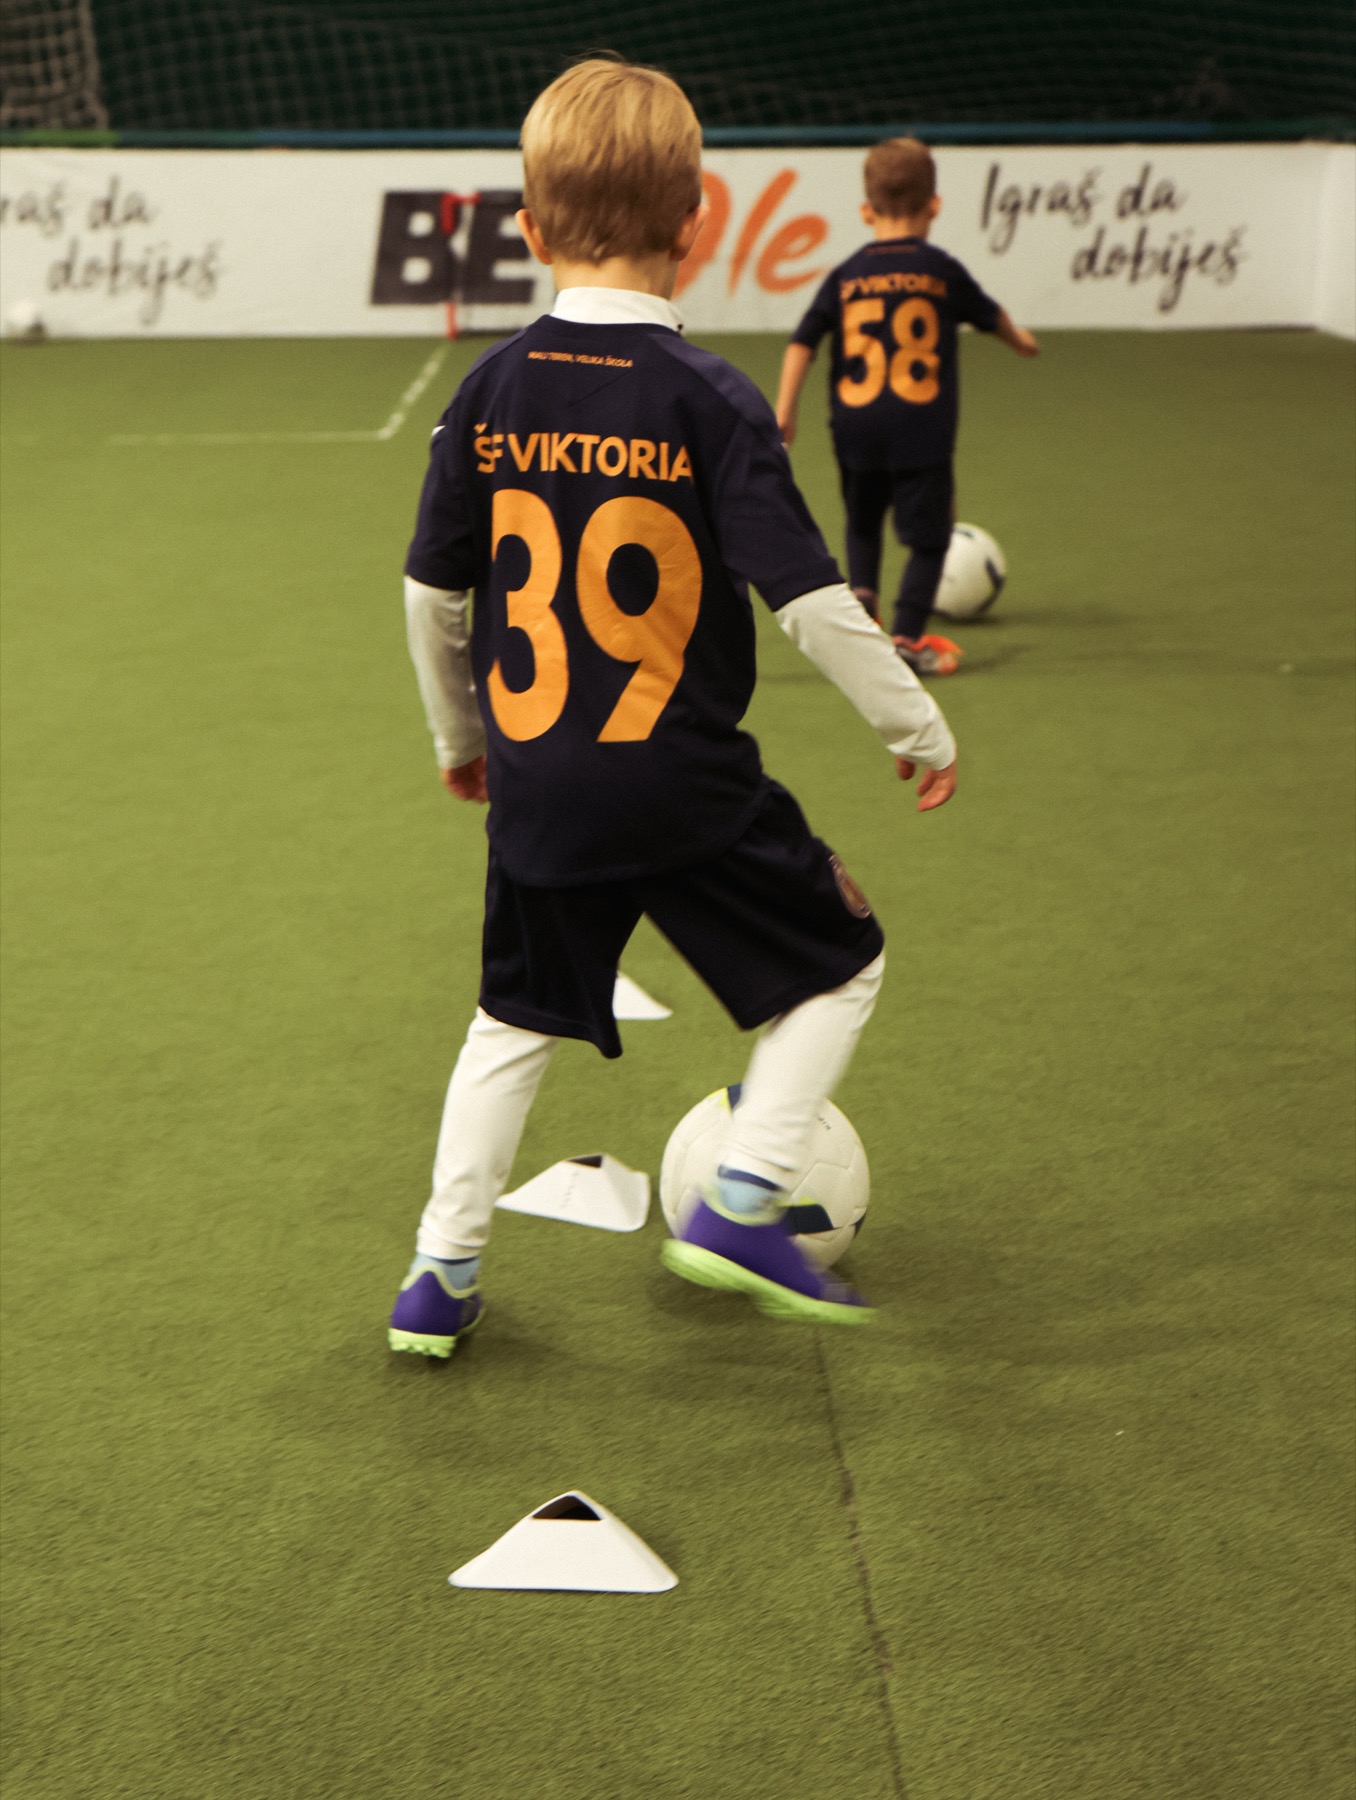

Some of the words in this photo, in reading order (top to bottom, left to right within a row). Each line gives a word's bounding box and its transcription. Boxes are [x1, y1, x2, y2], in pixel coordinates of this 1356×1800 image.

[87, 174, 156, 231] da
[979, 163, 1099, 253] Igraš
[1116, 164, 1184, 220] da
[48, 237, 222, 326] dobiješ
[1070, 225, 1244, 312] dobiješ
[837, 297, 941, 407] 58
[507, 432, 693, 482] VIKTORIA
[487, 488, 702, 742] 39
